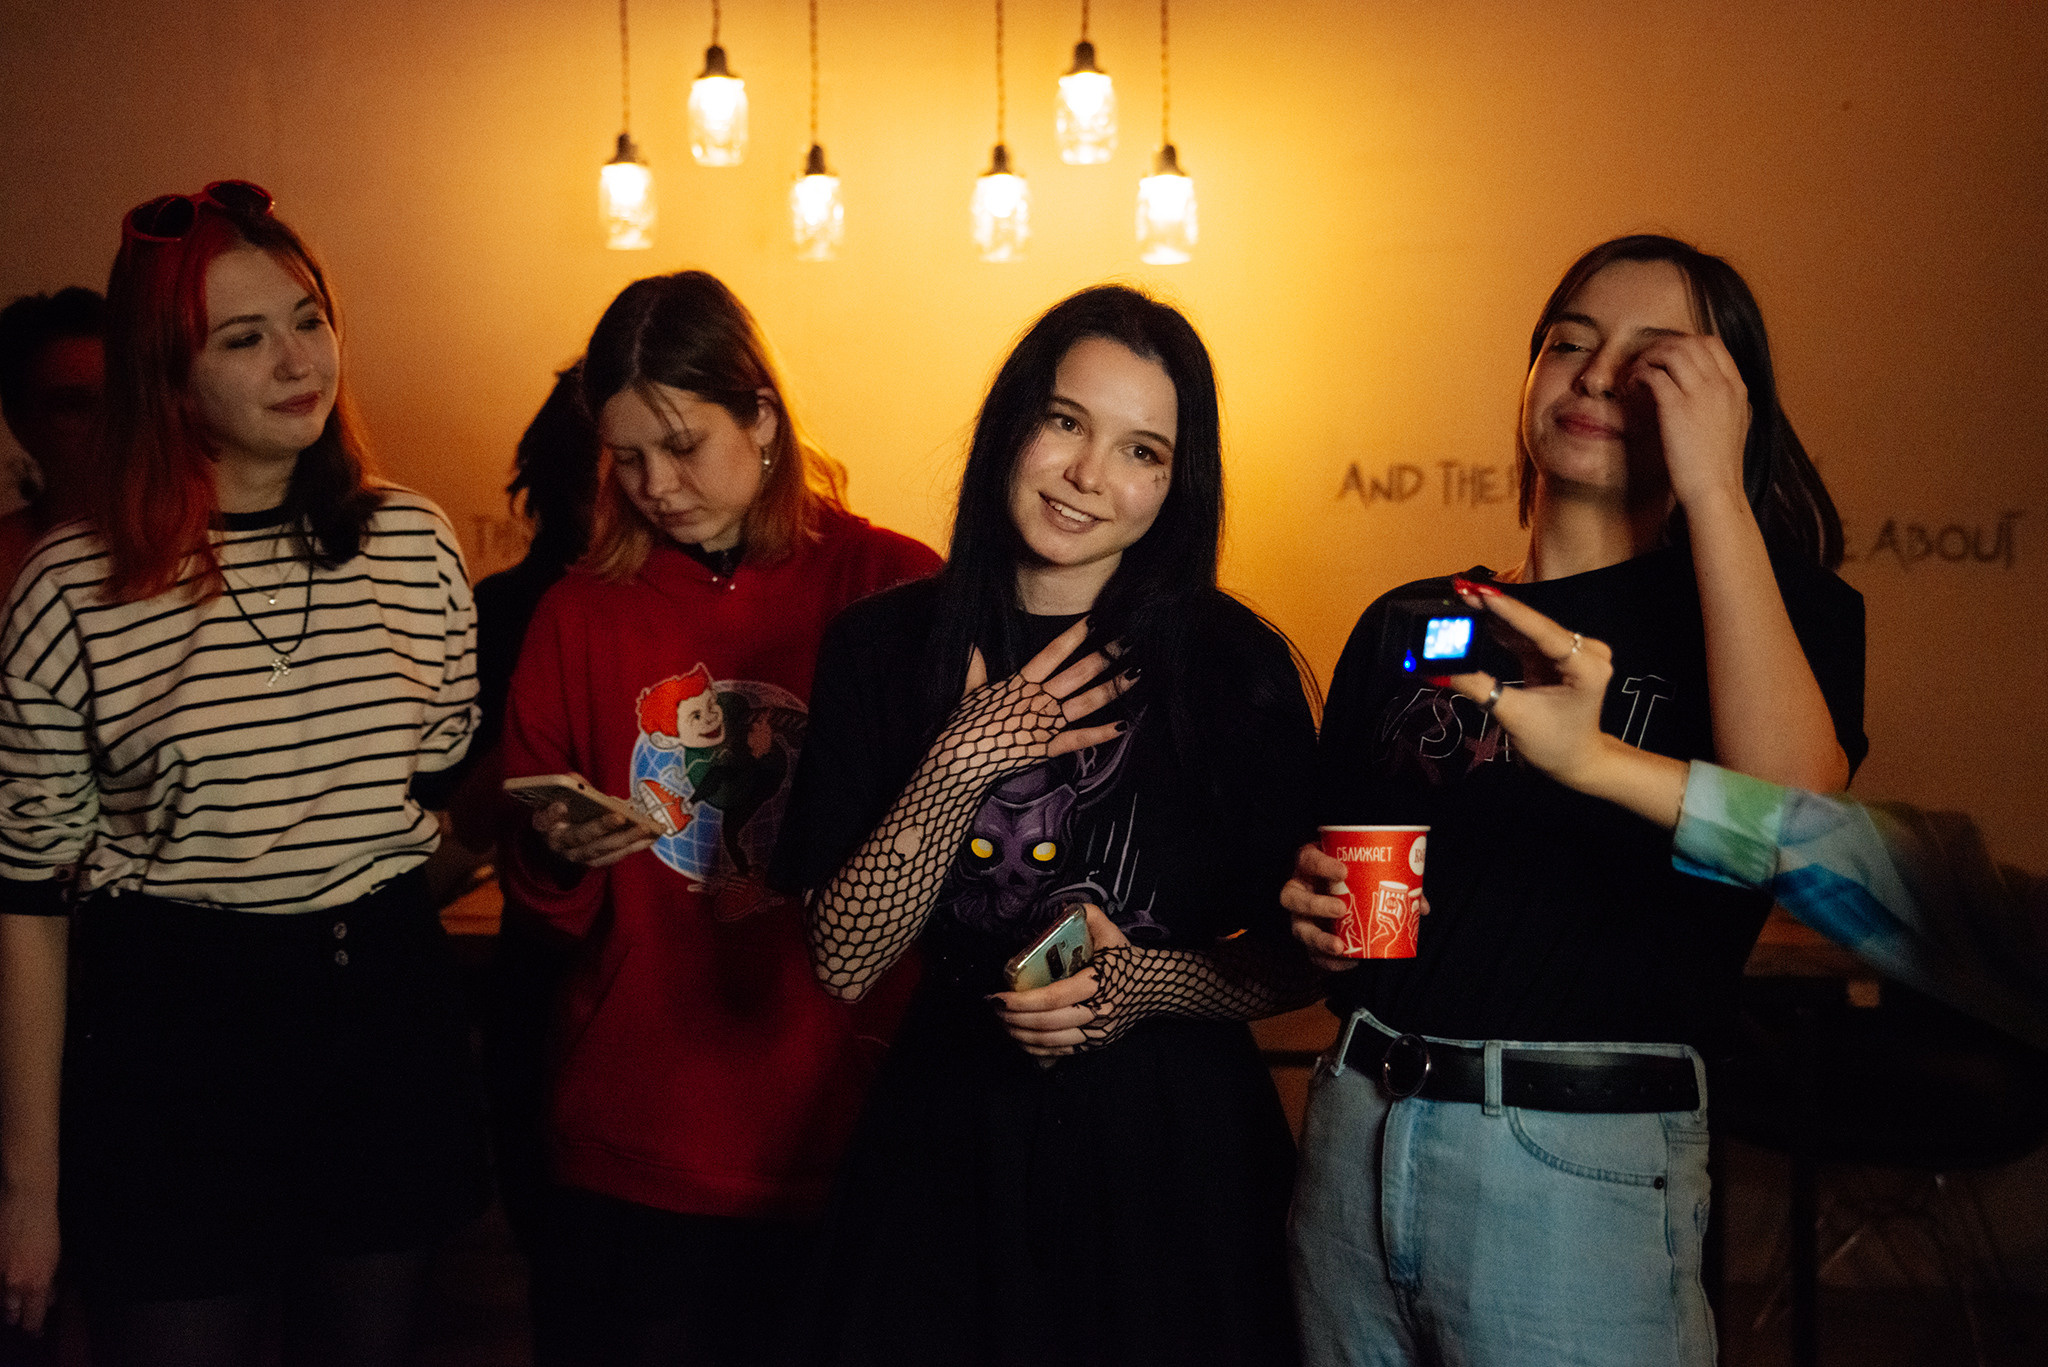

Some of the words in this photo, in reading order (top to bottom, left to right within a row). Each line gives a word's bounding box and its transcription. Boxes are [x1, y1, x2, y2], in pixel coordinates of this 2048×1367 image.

[1336, 460, 1424, 509] AND
[1866, 510, 2026, 572] ABOUT
[1336, 846, 1393, 862] СБЛИЖАЕТ
